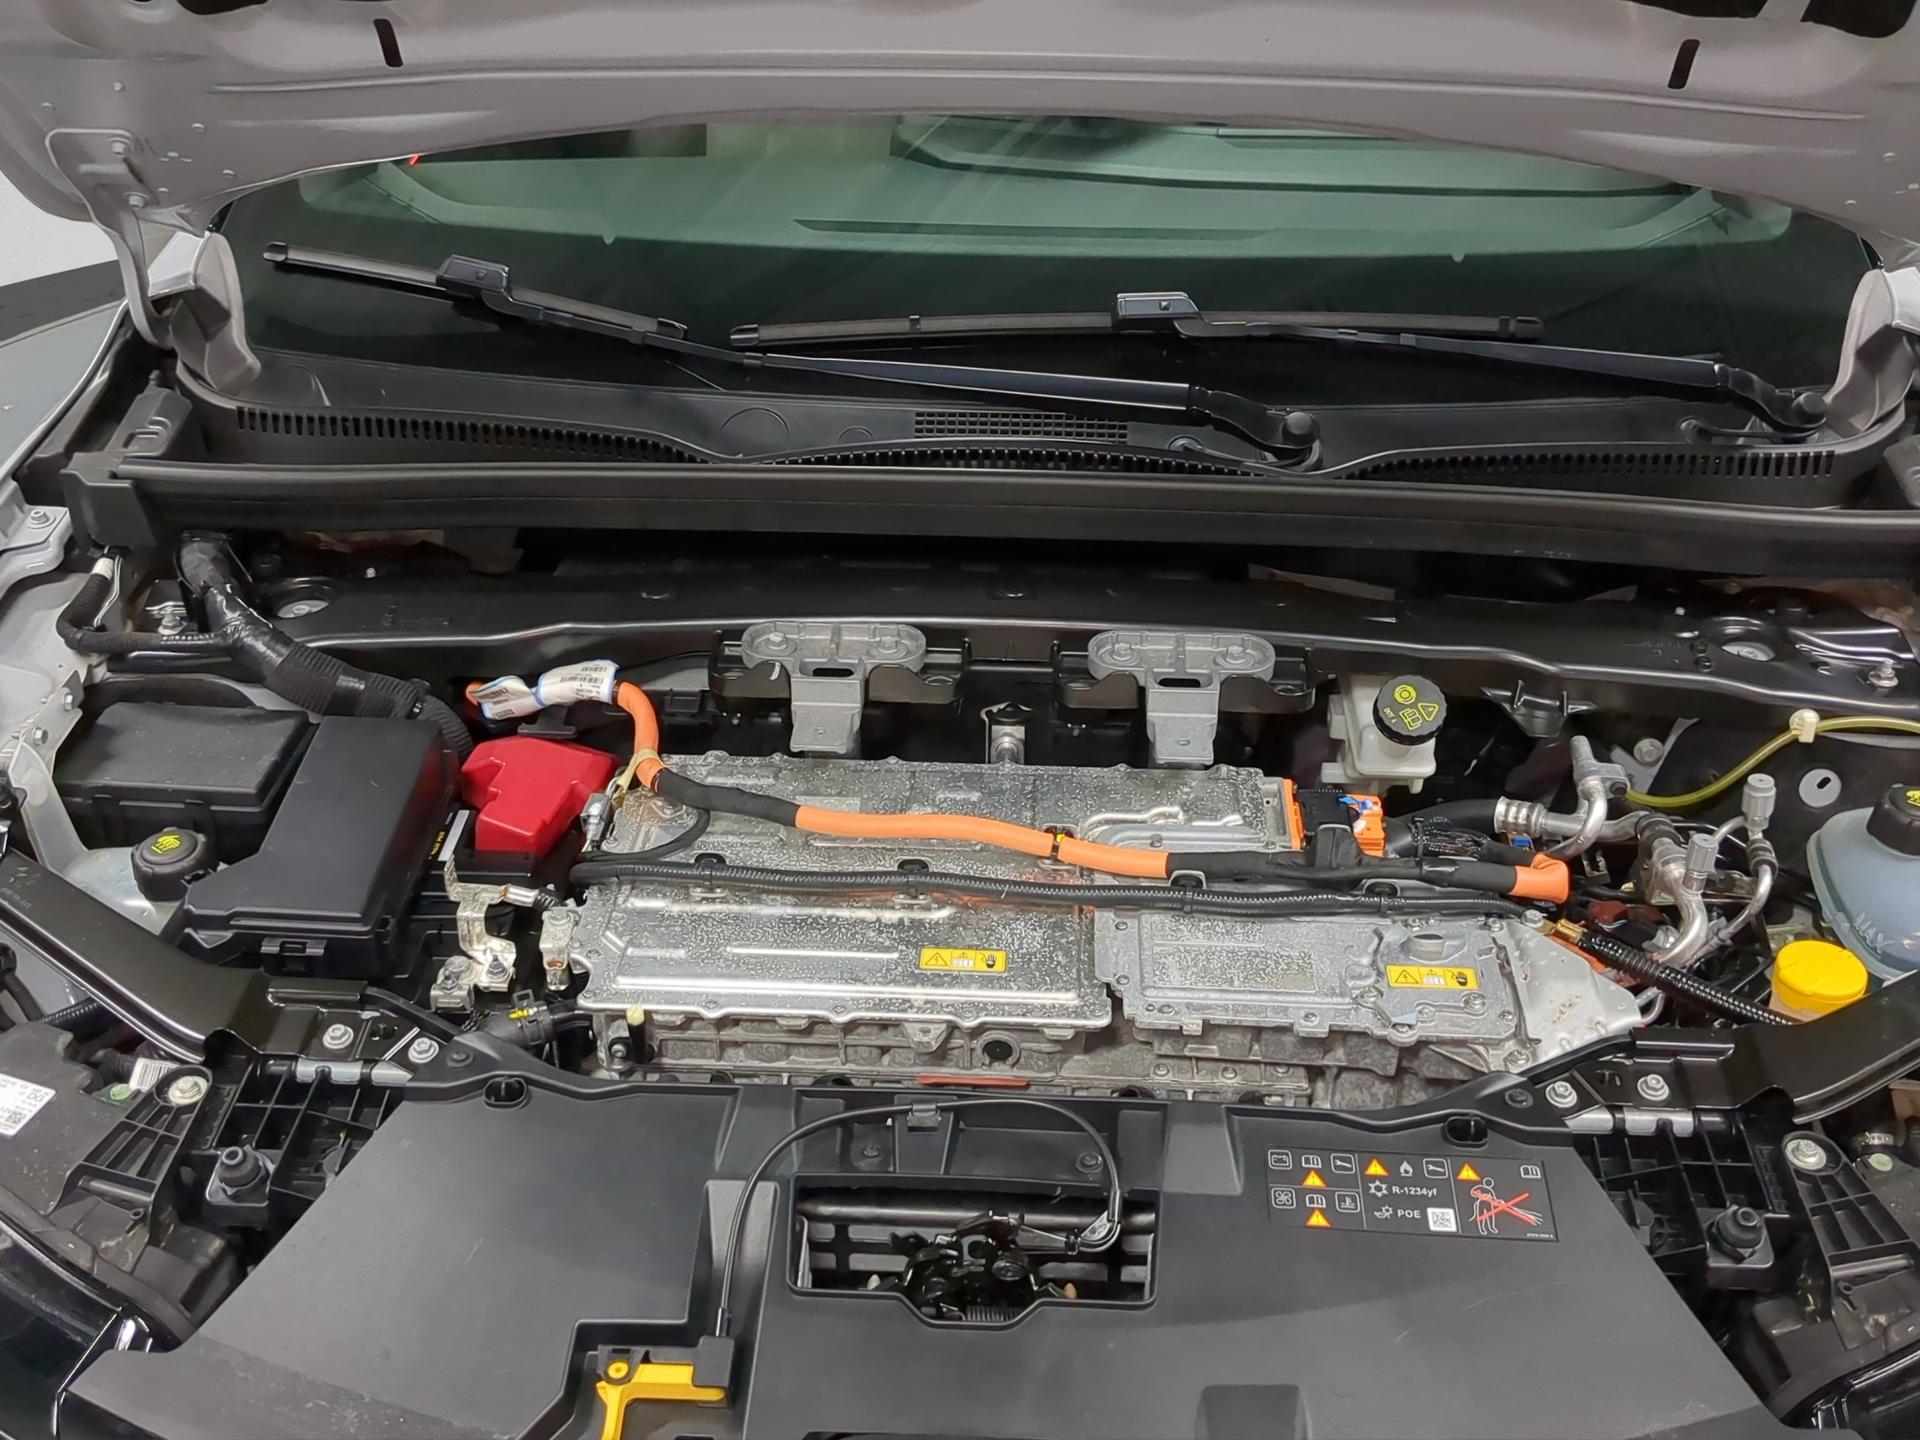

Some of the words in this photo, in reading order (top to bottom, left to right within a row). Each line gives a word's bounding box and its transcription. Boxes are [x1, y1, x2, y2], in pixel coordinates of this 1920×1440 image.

[1855, 912, 1897, 954] MAX
[1392, 1185, 1437, 1197] R-1234yf
[1397, 1208, 1422, 1219] POE
